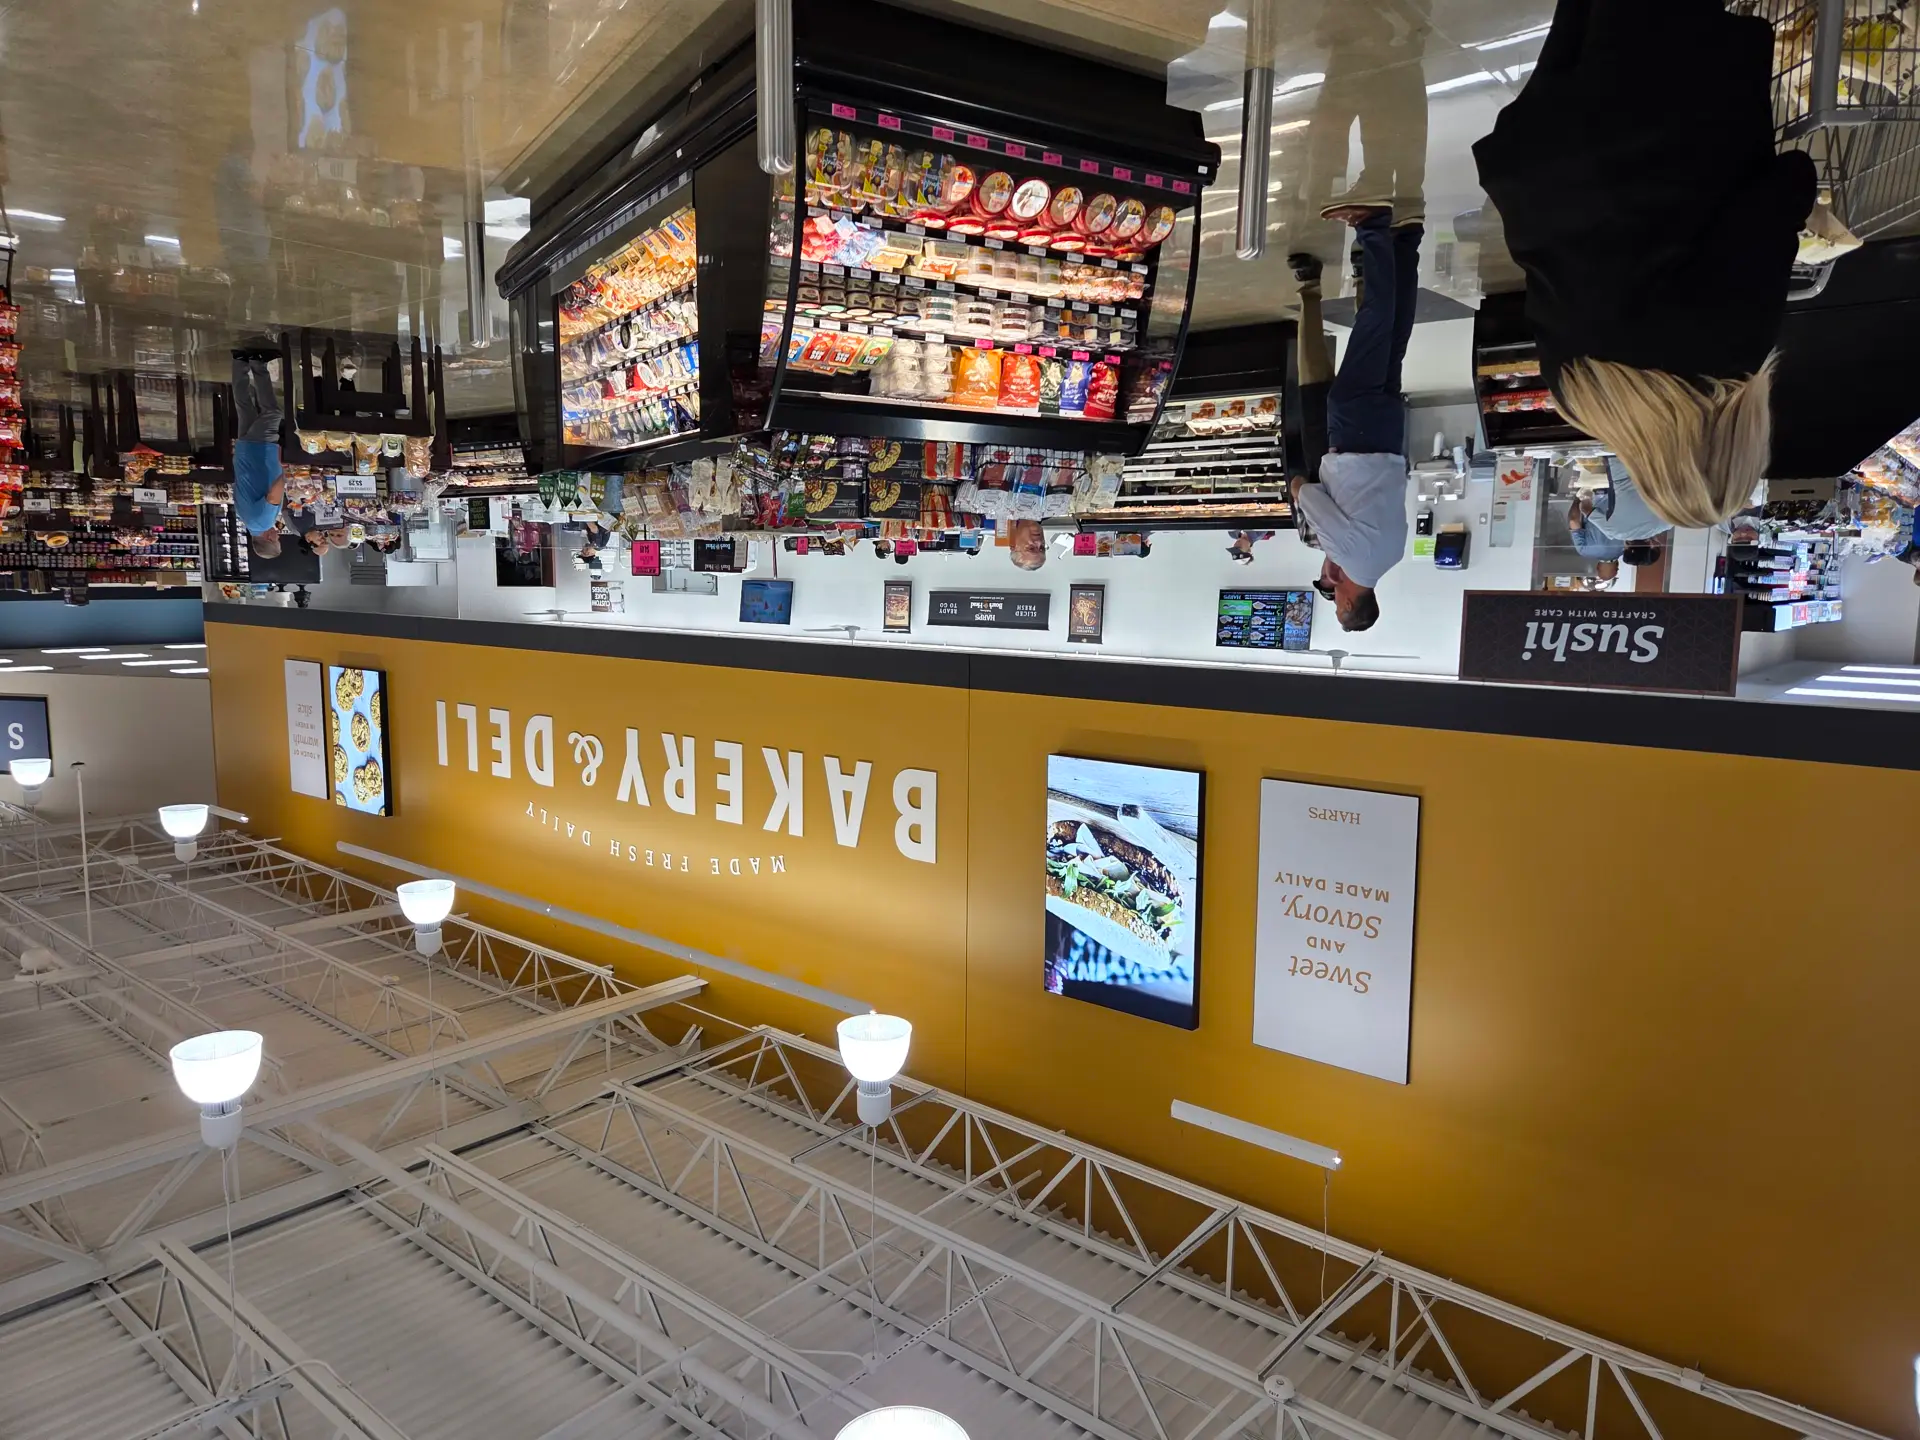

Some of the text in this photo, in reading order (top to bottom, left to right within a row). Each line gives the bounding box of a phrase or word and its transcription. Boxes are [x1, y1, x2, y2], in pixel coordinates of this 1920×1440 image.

[974, 613, 996, 621] HARPS
[1534, 608, 1656, 619] CRAFTED WITH CARE
[1521, 621, 1665, 663] Sushi
[292, 733, 319, 748] warmth
[436, 700, 938, 864] BAKERY & DELI
[1308, 806, 1361, 825] HARPS
[525, 801, 786, 875] MADE FRESH DAILY
[1274, 871, 1390, 903] MADE DAILY
[1280, 894, 1382, 939] Savory,
[1306, 936, 1345, 954] AND
[1288, 955, 1372, 994] Sweet
